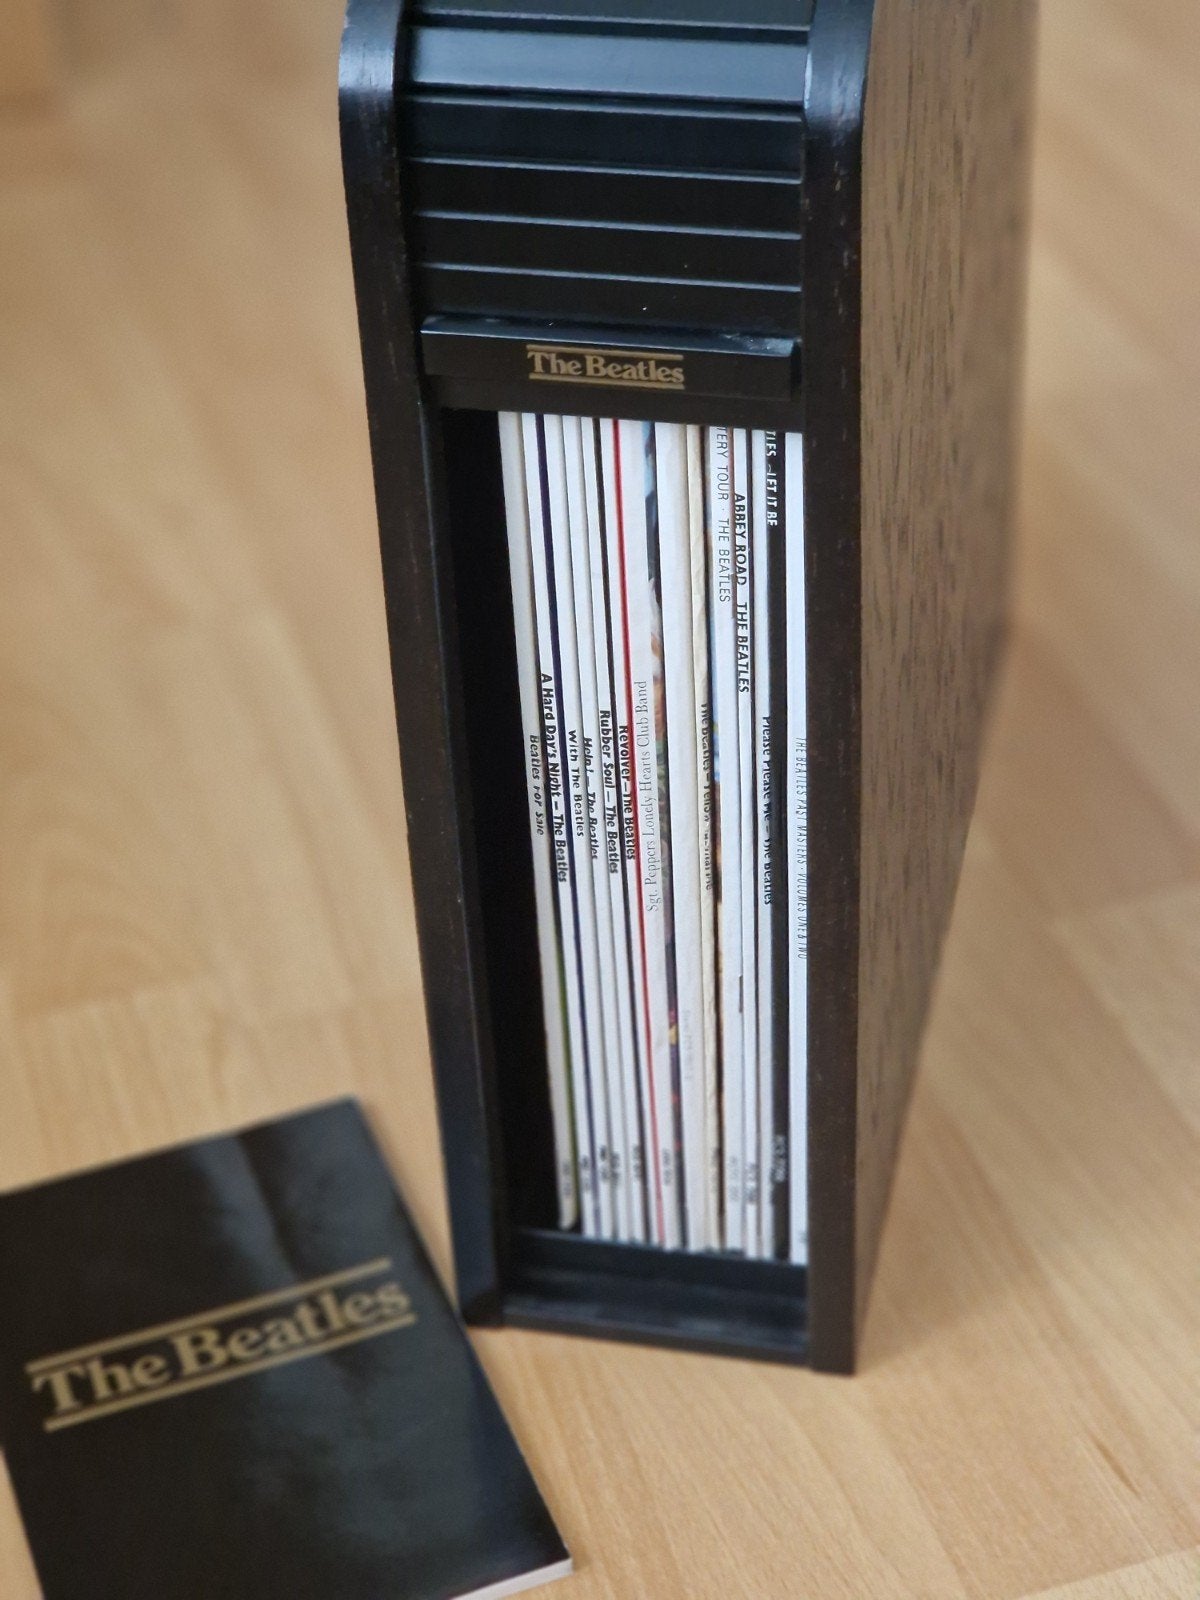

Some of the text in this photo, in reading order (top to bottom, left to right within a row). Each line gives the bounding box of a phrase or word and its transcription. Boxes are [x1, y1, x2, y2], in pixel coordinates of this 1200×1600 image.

[527, 351, 685, 384] The Beatles
[717, 466, 730, 501] TOUR
[718, 518, 731, 541] THE
[718, 549, 731, 602] BEATLES
[735, 493, 750, 693] ABBEY ROAD THE BEATLES
[541, 673, 553, 683] A
[542, 688, 556, 720] Hard
[600, 710, 613, 759] Rubber
[530, 735, 541, 780] Beatles
[603, 763, 615, 789] Soul
[795, 757, 807, 795] BEATLES
[549, 762, 562, 798] Night
[568, 730, 585, 838] With The Beatles
[634, 680, 662, 912] Sgt. Peppers Lonely Hearts Club Band
[588, 792, 597, 813] The
[606, 806, 617, 828] The
[553, 815, 565, 836] The
[589, 818, 600, 859] Beatles
[624, 818, 636, 860] Beatles
[797, 824, 807, 864] MASTERS
[555, 840, 569, 883] Beatles
[607, 831, 620, 874] Beatles
[797, 873, 807, 912] VOLUMES
[31, 1281, 411, 1414] The Beatles
